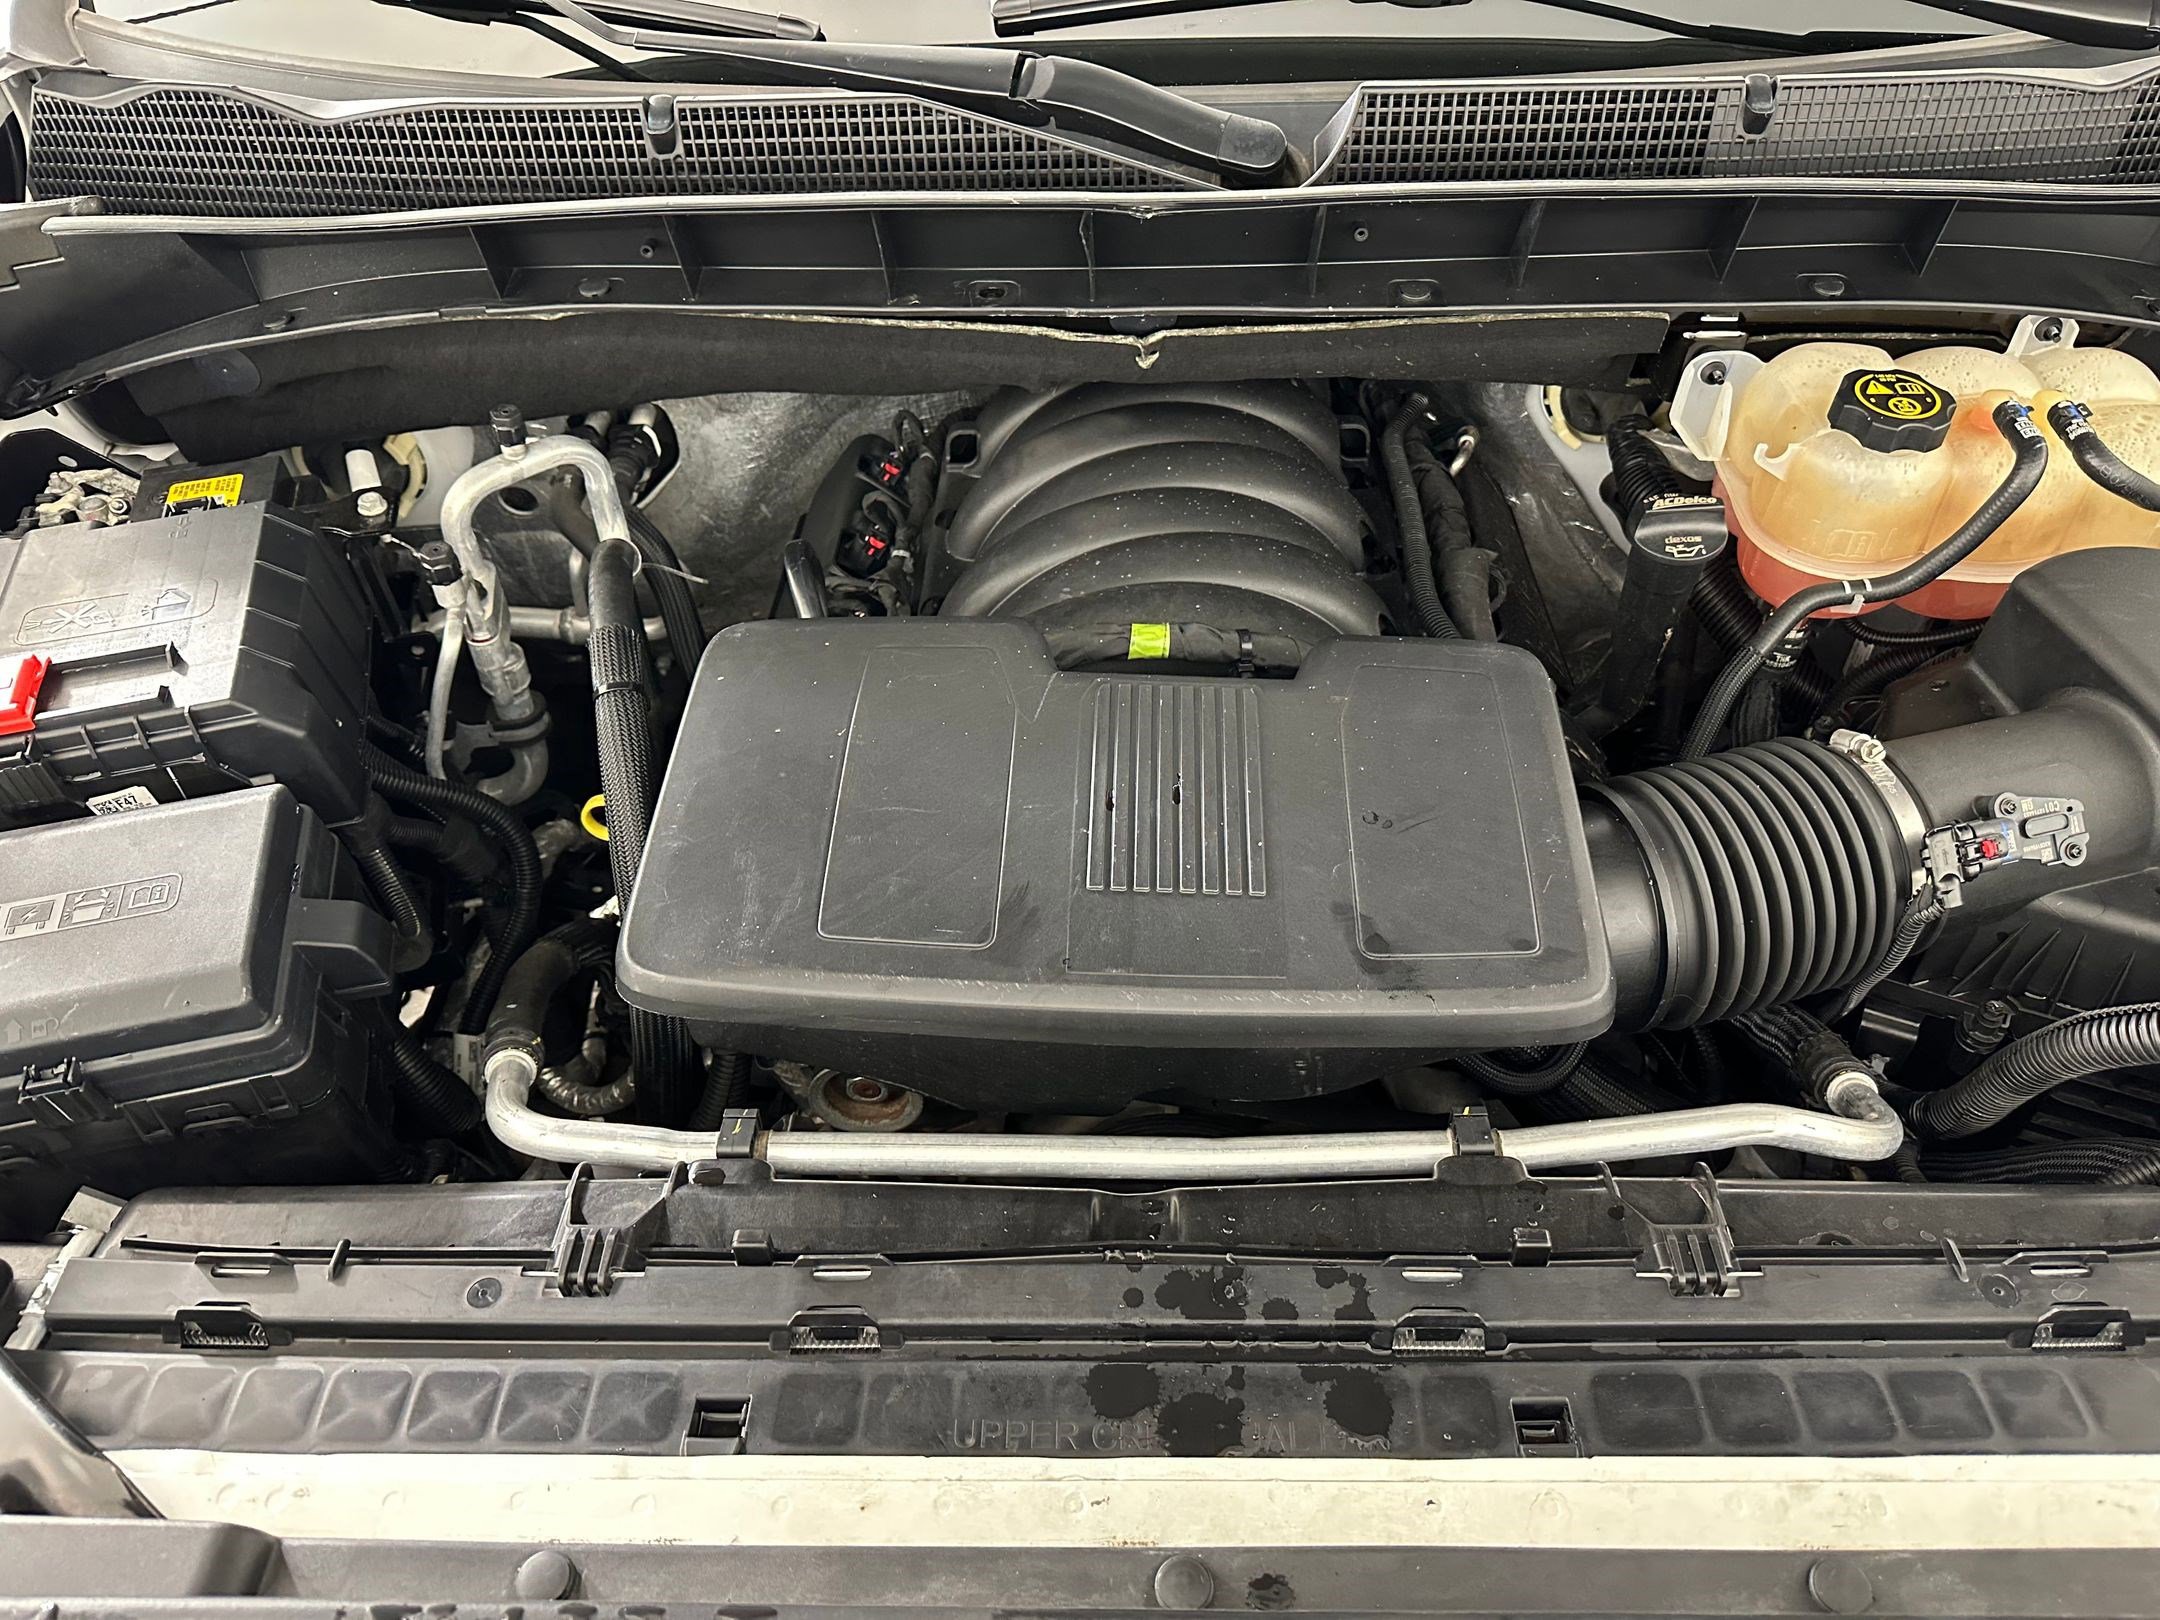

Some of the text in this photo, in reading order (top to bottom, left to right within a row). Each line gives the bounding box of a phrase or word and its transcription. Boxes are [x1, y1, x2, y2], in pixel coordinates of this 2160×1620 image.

[1652, 495, 1717, 510] ACDelco
[1665, 535, 1702, 544] dexos
[114, 795, 138, 809] F47
[952, 1417, 1081, 1452] UPPER
